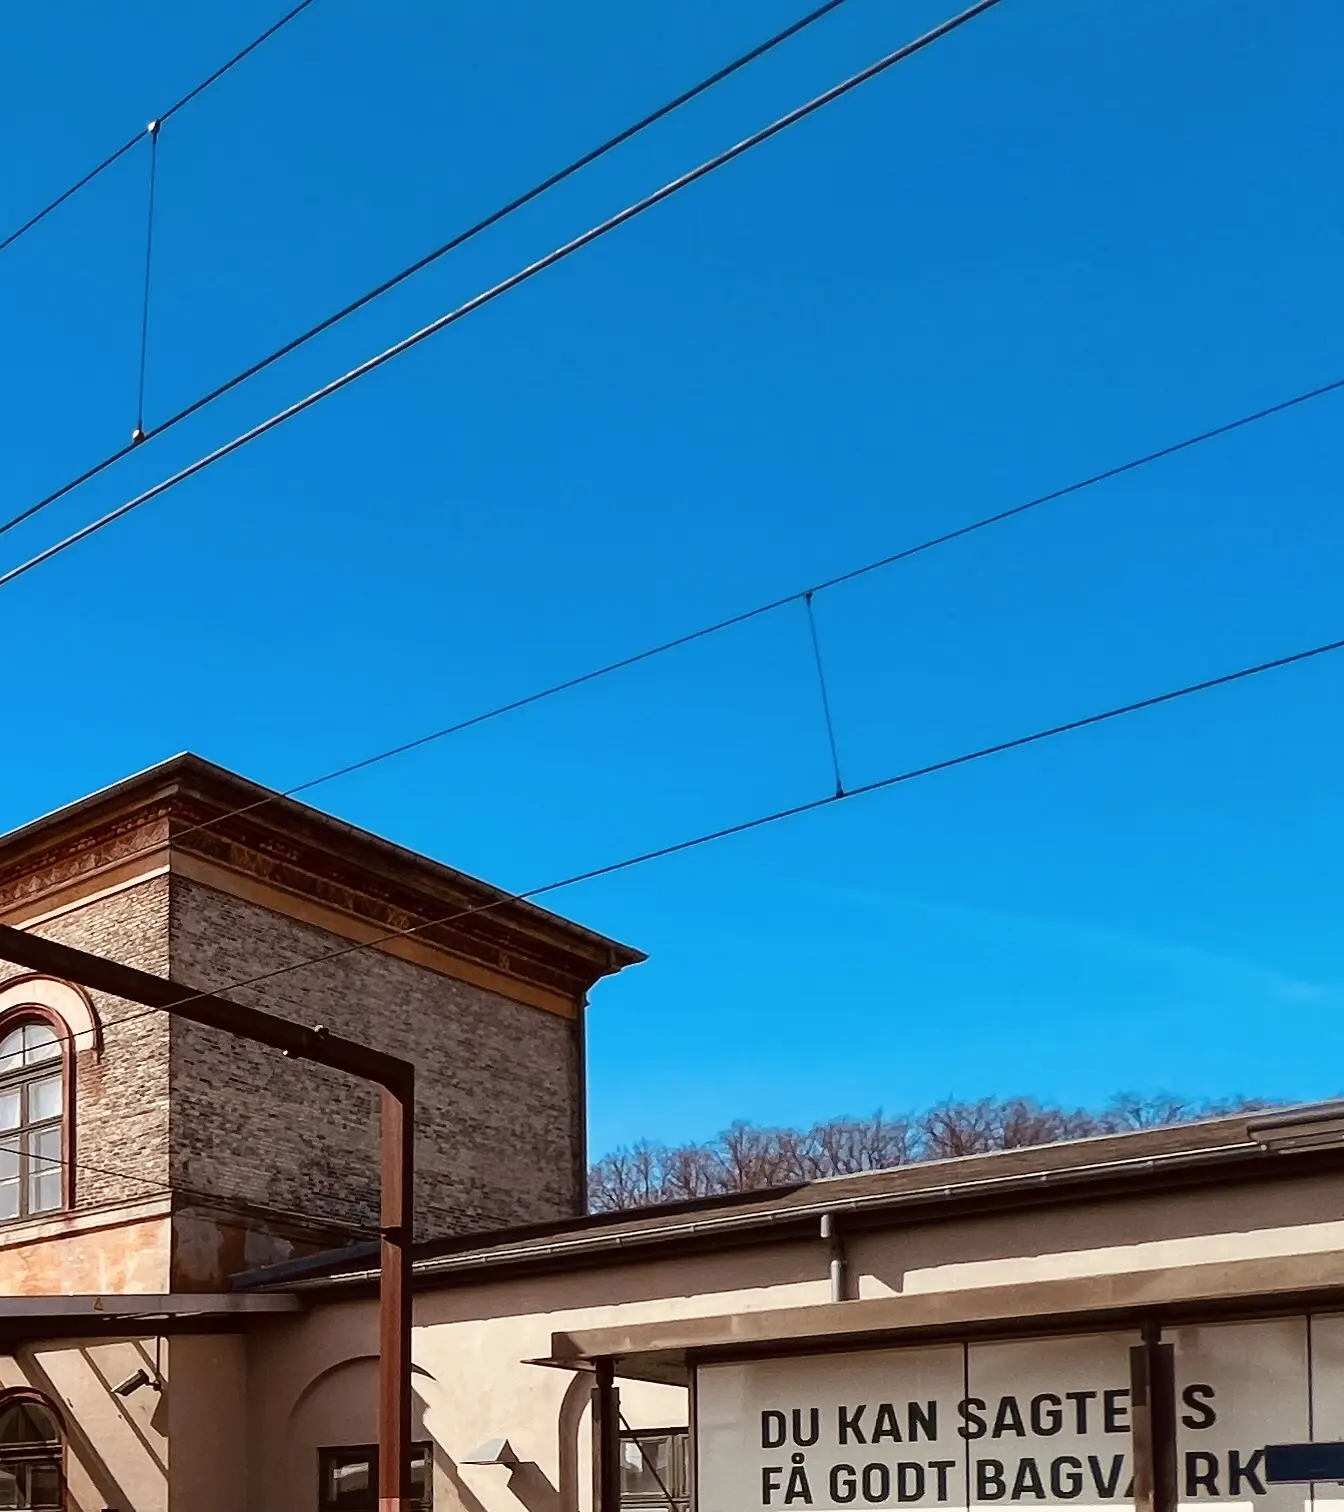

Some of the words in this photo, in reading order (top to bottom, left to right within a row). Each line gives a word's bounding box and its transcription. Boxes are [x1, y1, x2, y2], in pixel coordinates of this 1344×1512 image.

[761, 1407, 820, 1449] DU
[837, 1400, 938, 1445] KAN
[956, 1384, 1217, 1441] SAGTES
[761, 1452, 813, 1505] FÅ
[829, 1460, 956, 1504] GODT
[976, 1449, 1267, 1501] BAGVRK
